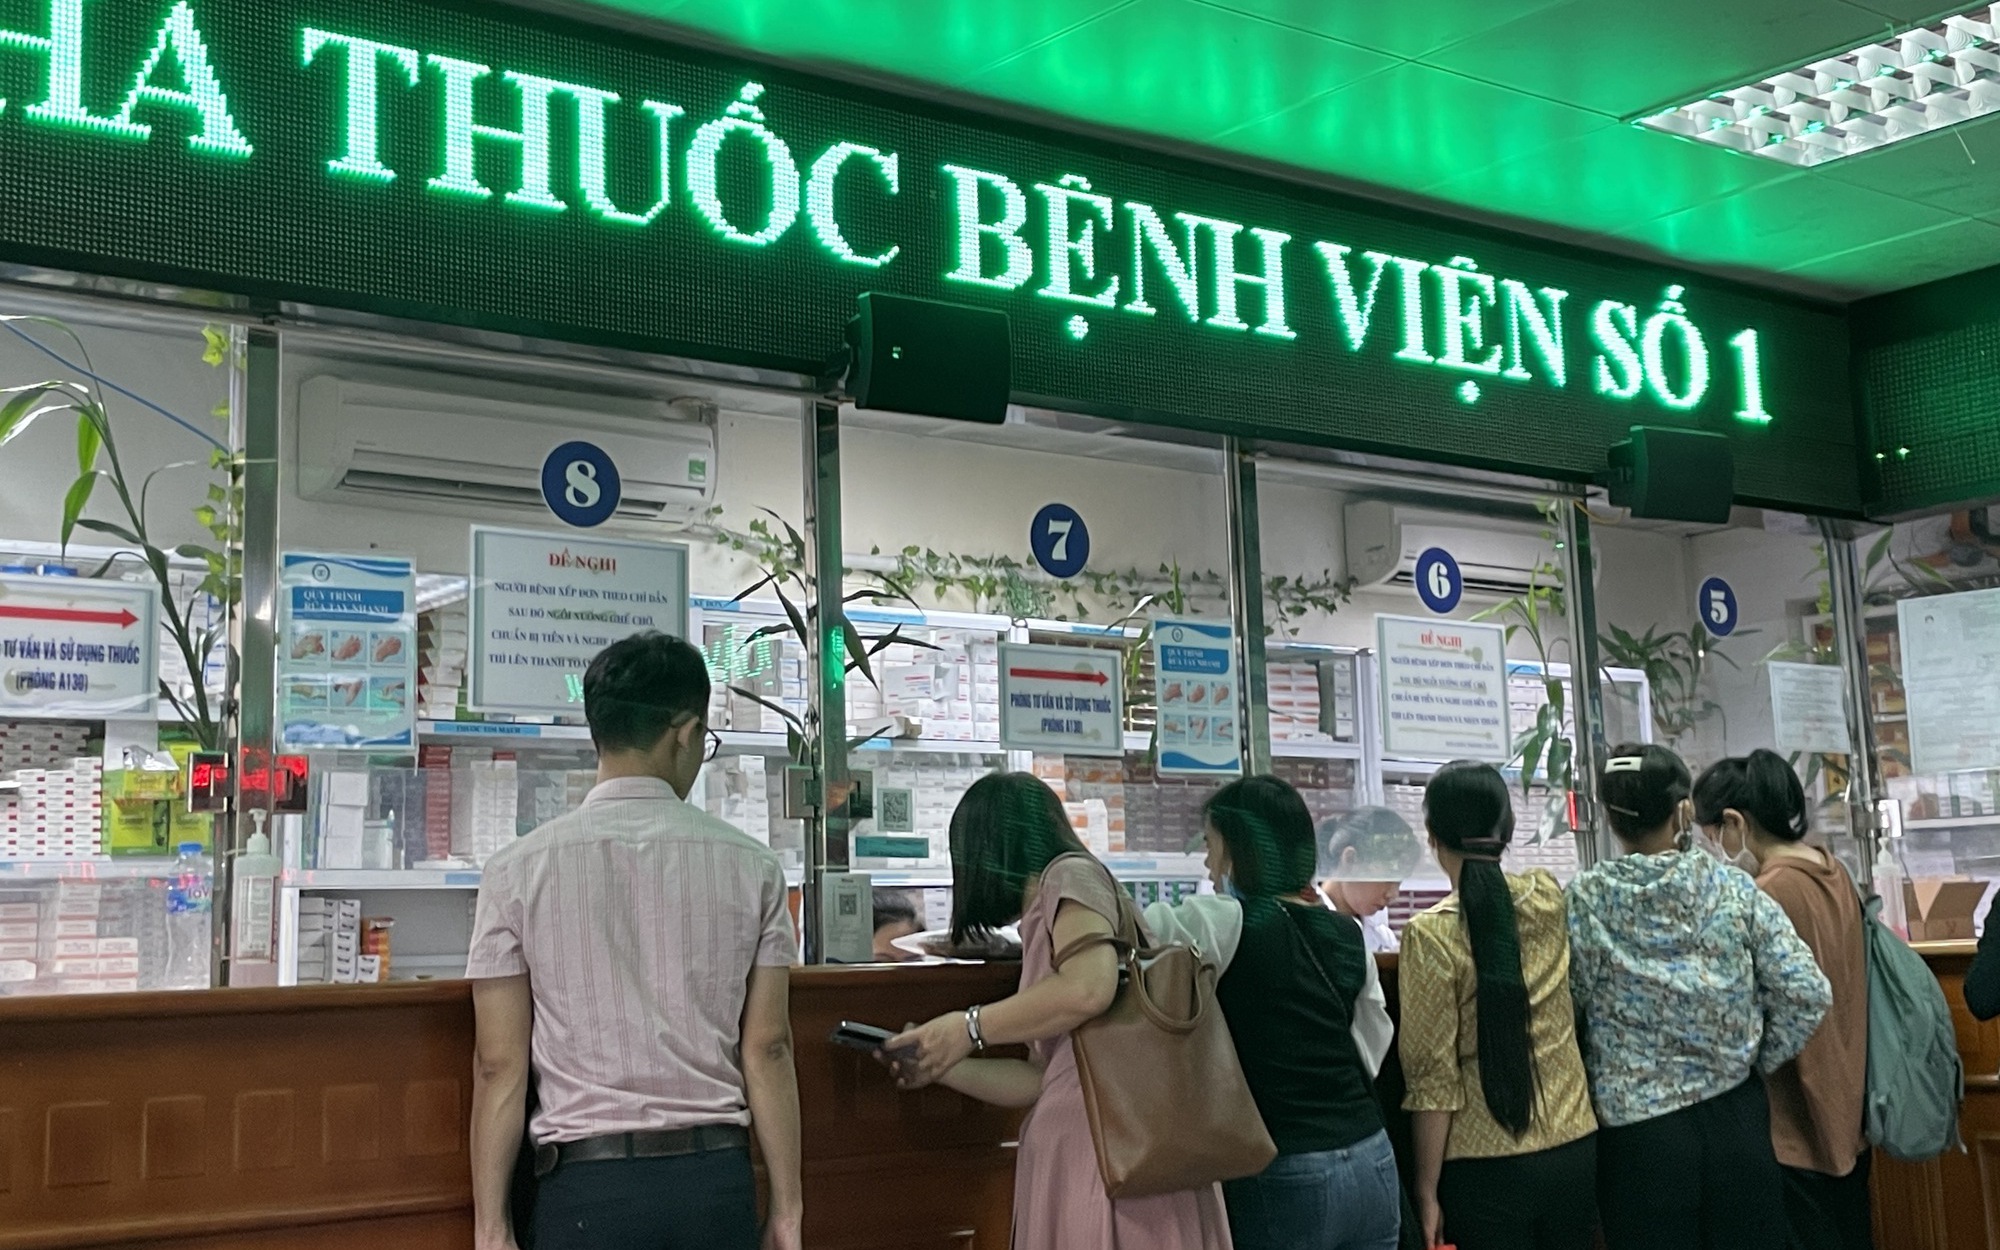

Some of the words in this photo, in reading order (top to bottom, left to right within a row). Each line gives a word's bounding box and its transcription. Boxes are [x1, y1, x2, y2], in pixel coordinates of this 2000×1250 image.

[301, 26, 900, 268] THUỐC
[943, 162, 1297, 341] BỆNH
[1314, 240, 1569, 406] VIỆN
[1593, 283, 1711, 411] SỐ
[1729, 327, 1773, 424] 1
[565, 459, 601, 508] 8
[1047, 518, 1073, 561] 7
[602, 590, 628, 601] THEO
[1428, 561, 1451, 599] 6
[508, 607, 528, 618] SAU
[1709, 588, 1729, 625] 5
[108, 640, 140, 665] THUỐC
[58, 672, 88, 693] A130)
